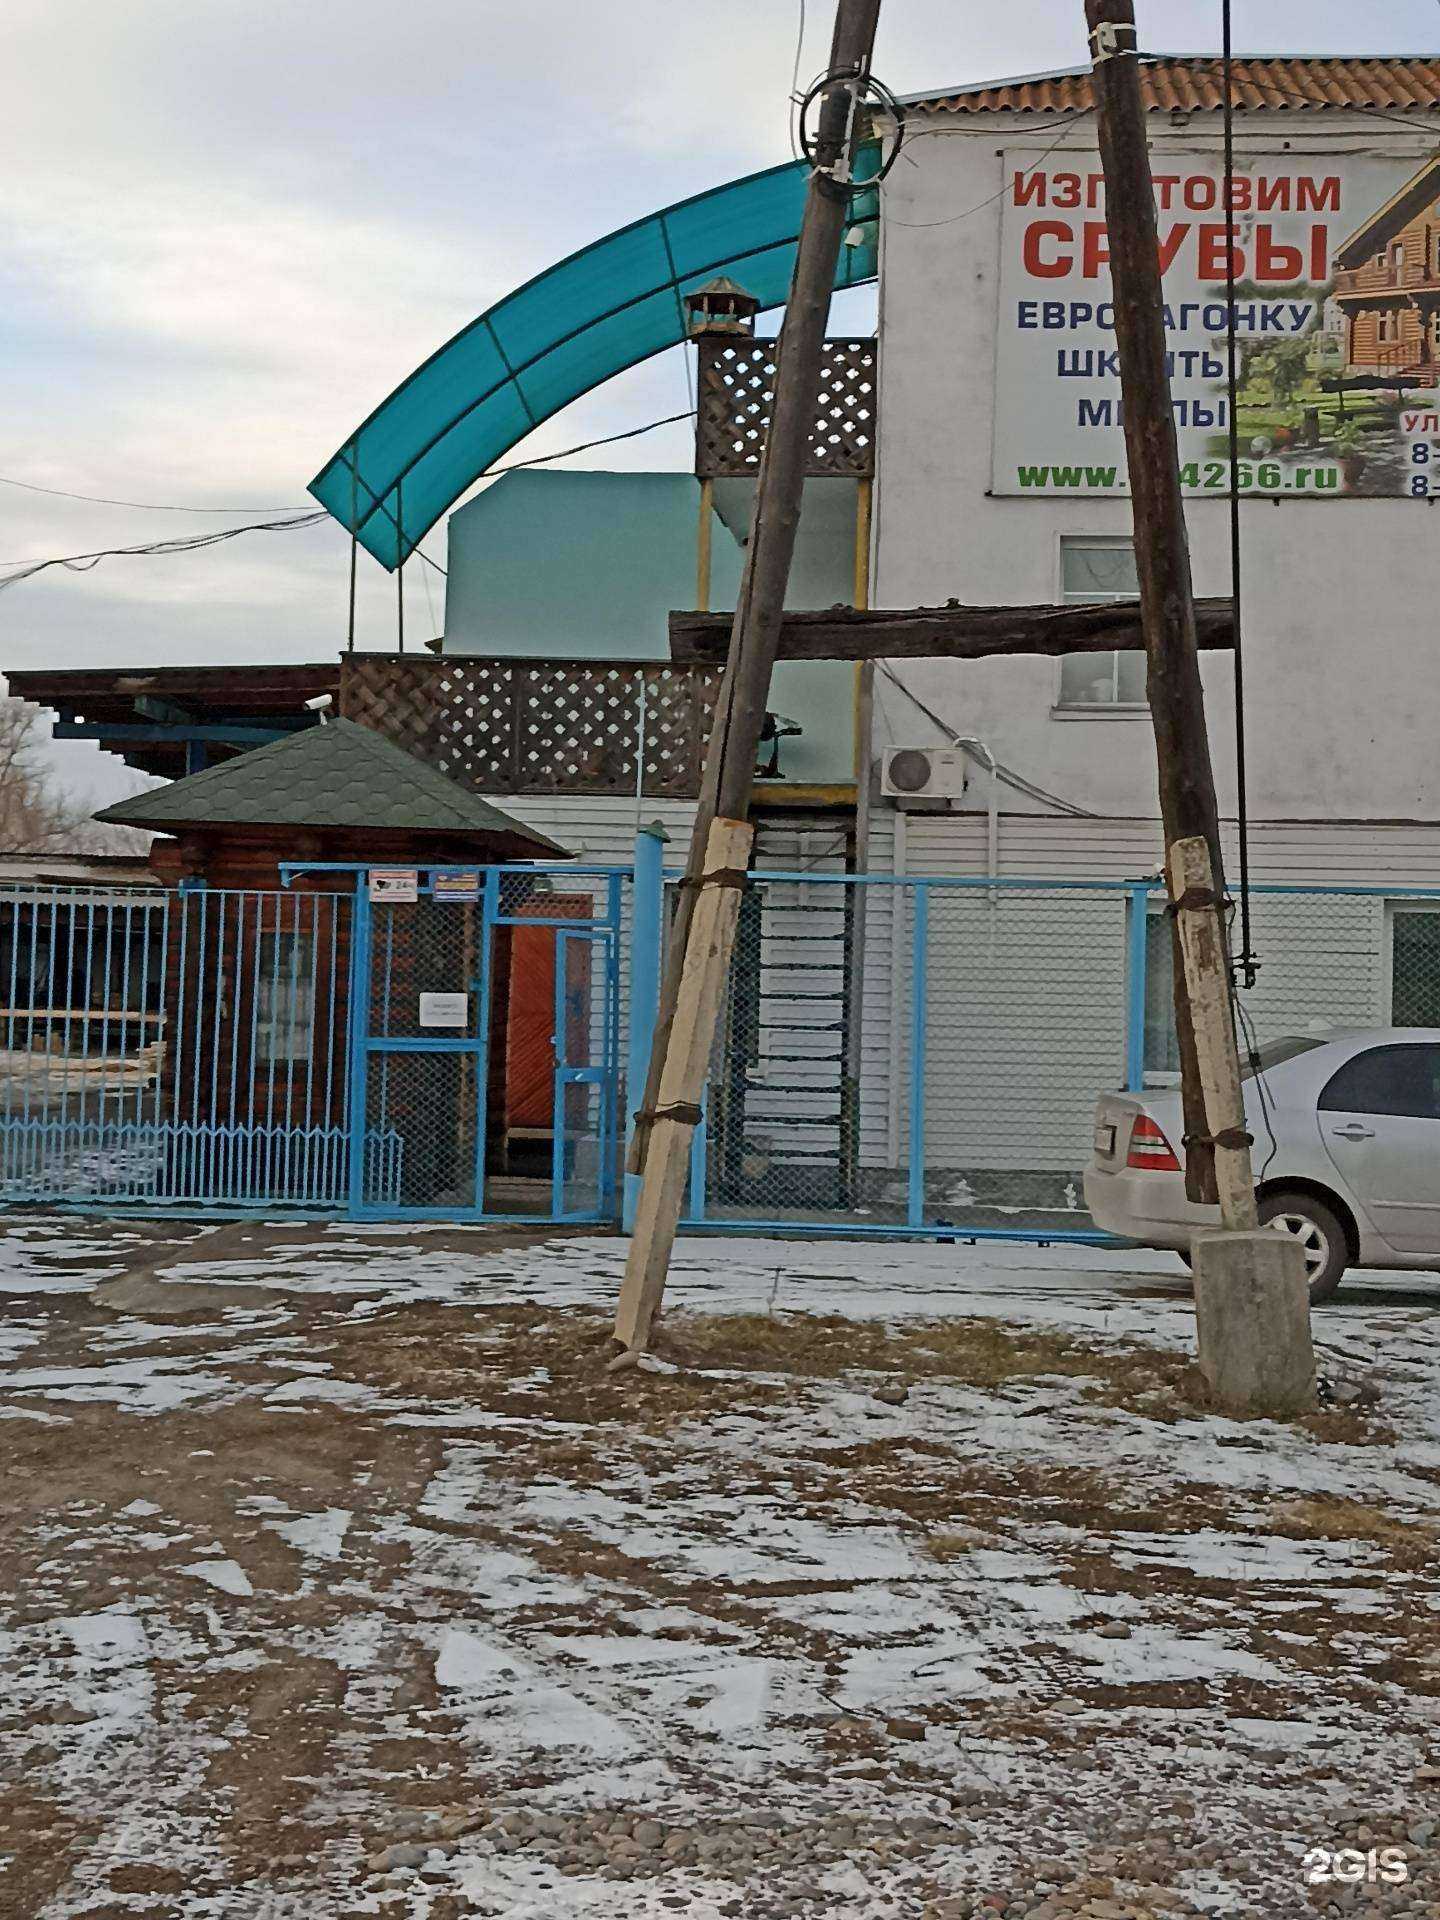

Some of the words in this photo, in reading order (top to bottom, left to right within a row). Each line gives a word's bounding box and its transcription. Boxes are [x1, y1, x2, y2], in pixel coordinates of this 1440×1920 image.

[1013, 172, 1341, 212] ИЗГТОВИМ
[1017, 301, 1313, 332] ЕВРОАГОНКУ
[1017, 461, 1338, 489] www.4266.ru
